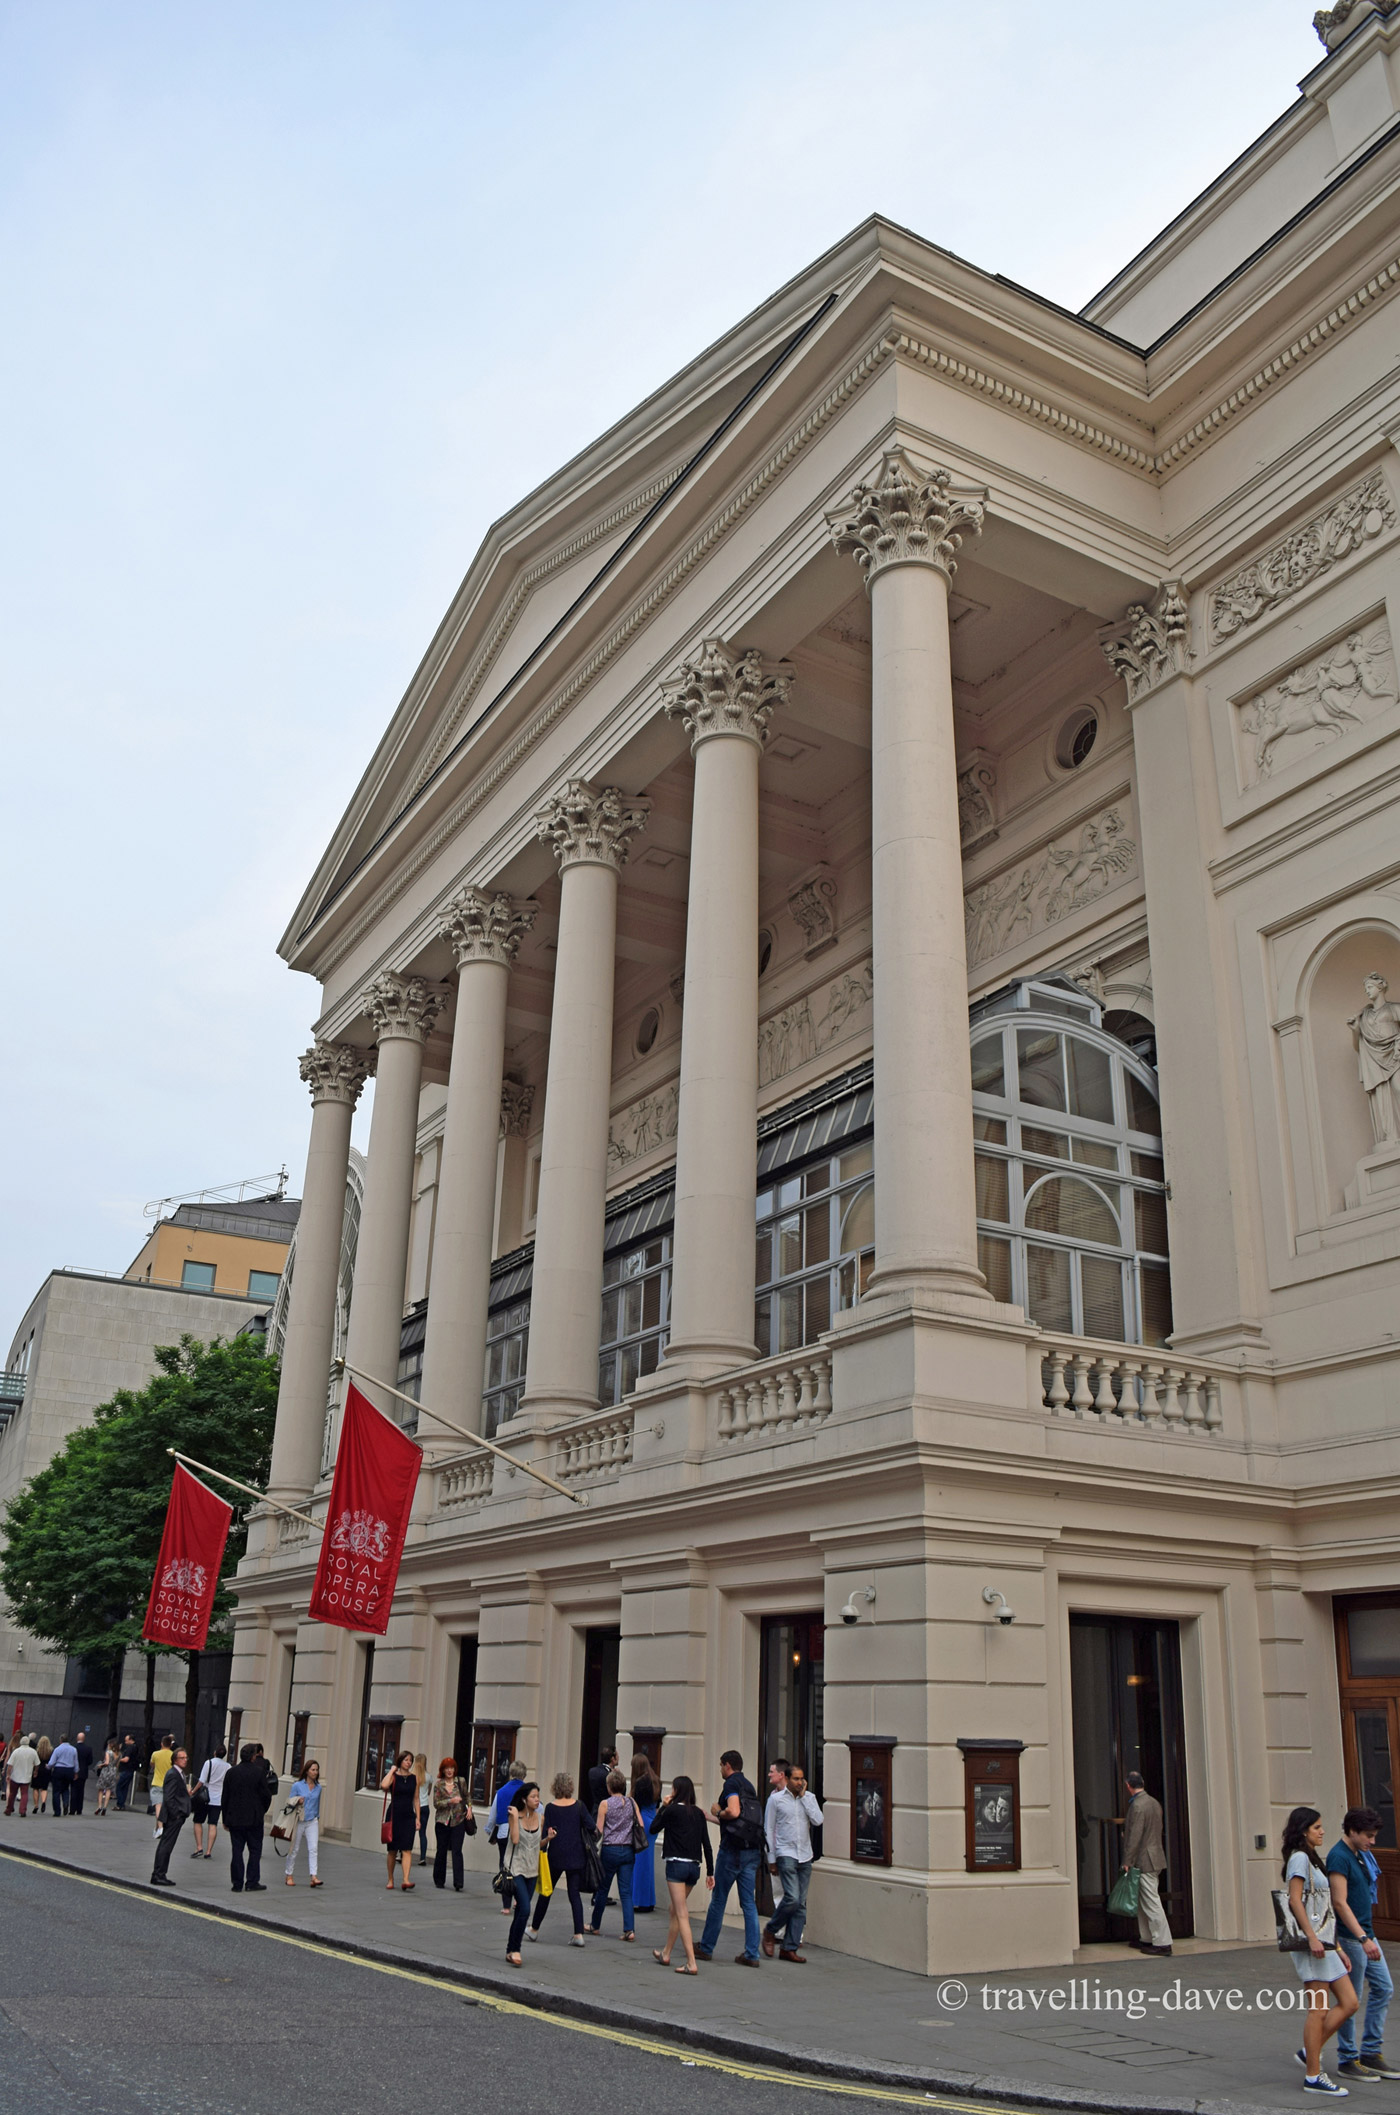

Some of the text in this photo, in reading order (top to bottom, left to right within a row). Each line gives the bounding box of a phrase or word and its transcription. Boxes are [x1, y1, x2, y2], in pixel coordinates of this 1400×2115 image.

[328, 1554, 381, 1580] ROYAL
[158, 1590, 200, 1610] ROYAL
[155, 1603, 199, 1622] OPERA
[153, 1616, 197, 1635] HOUSE
